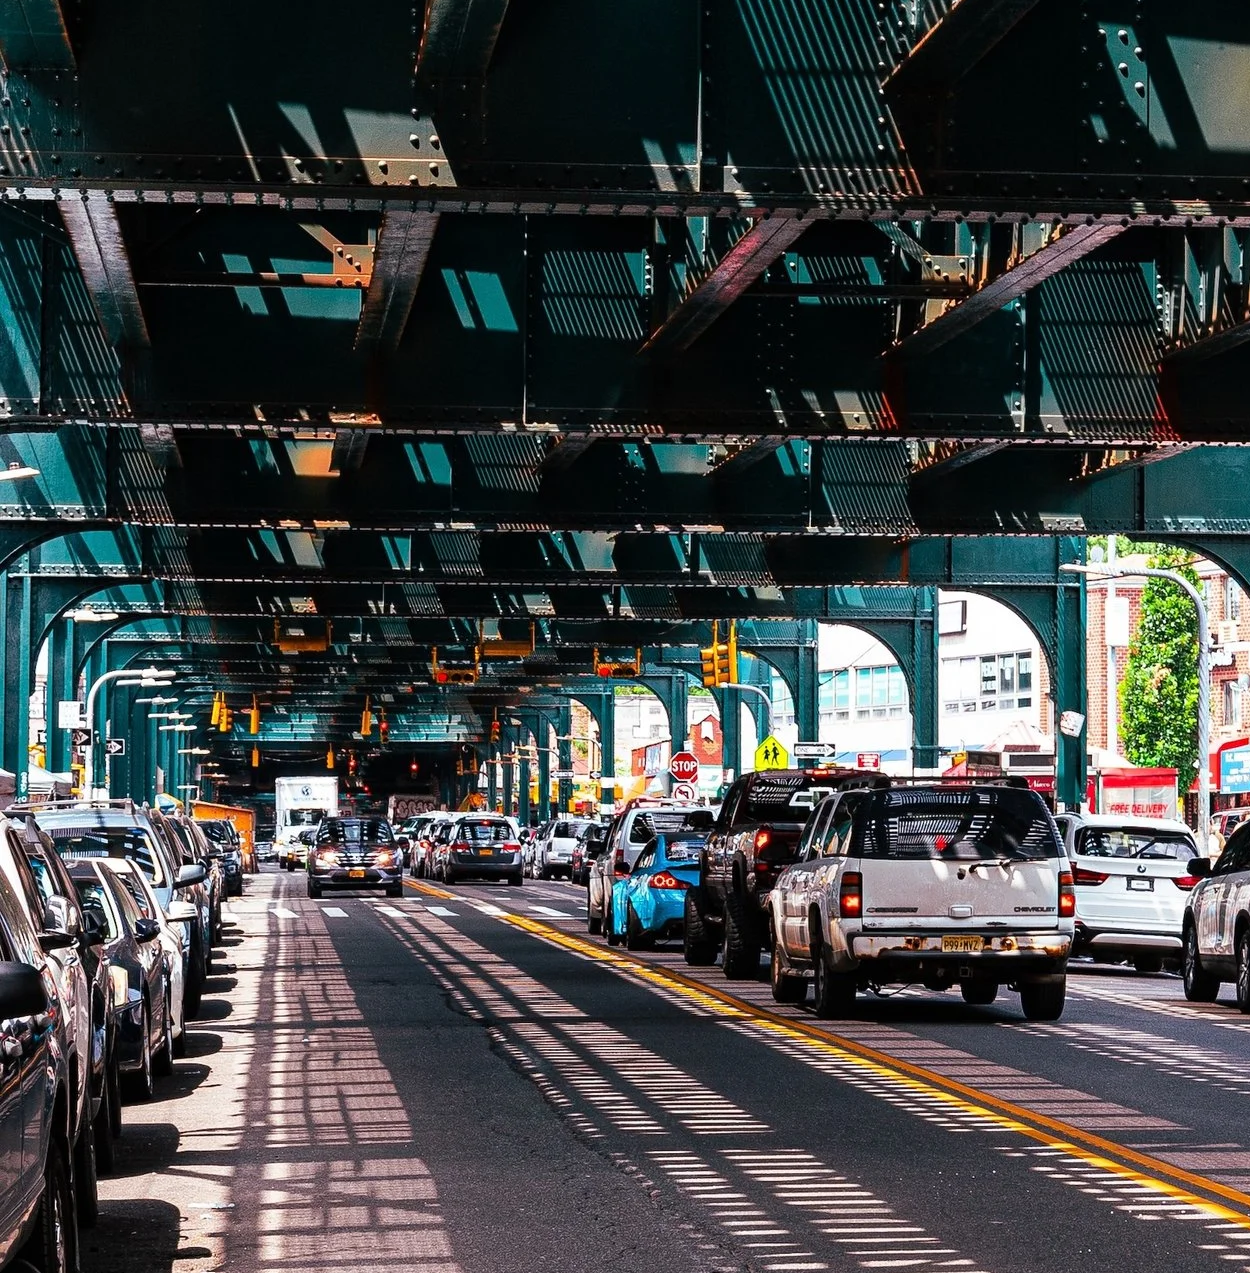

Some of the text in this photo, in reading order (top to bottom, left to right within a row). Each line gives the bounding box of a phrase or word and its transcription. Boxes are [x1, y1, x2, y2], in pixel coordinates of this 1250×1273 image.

[672, 761, 697, 772] STOP
[1110, 804, 1168, 814] FREE DELIVERY
